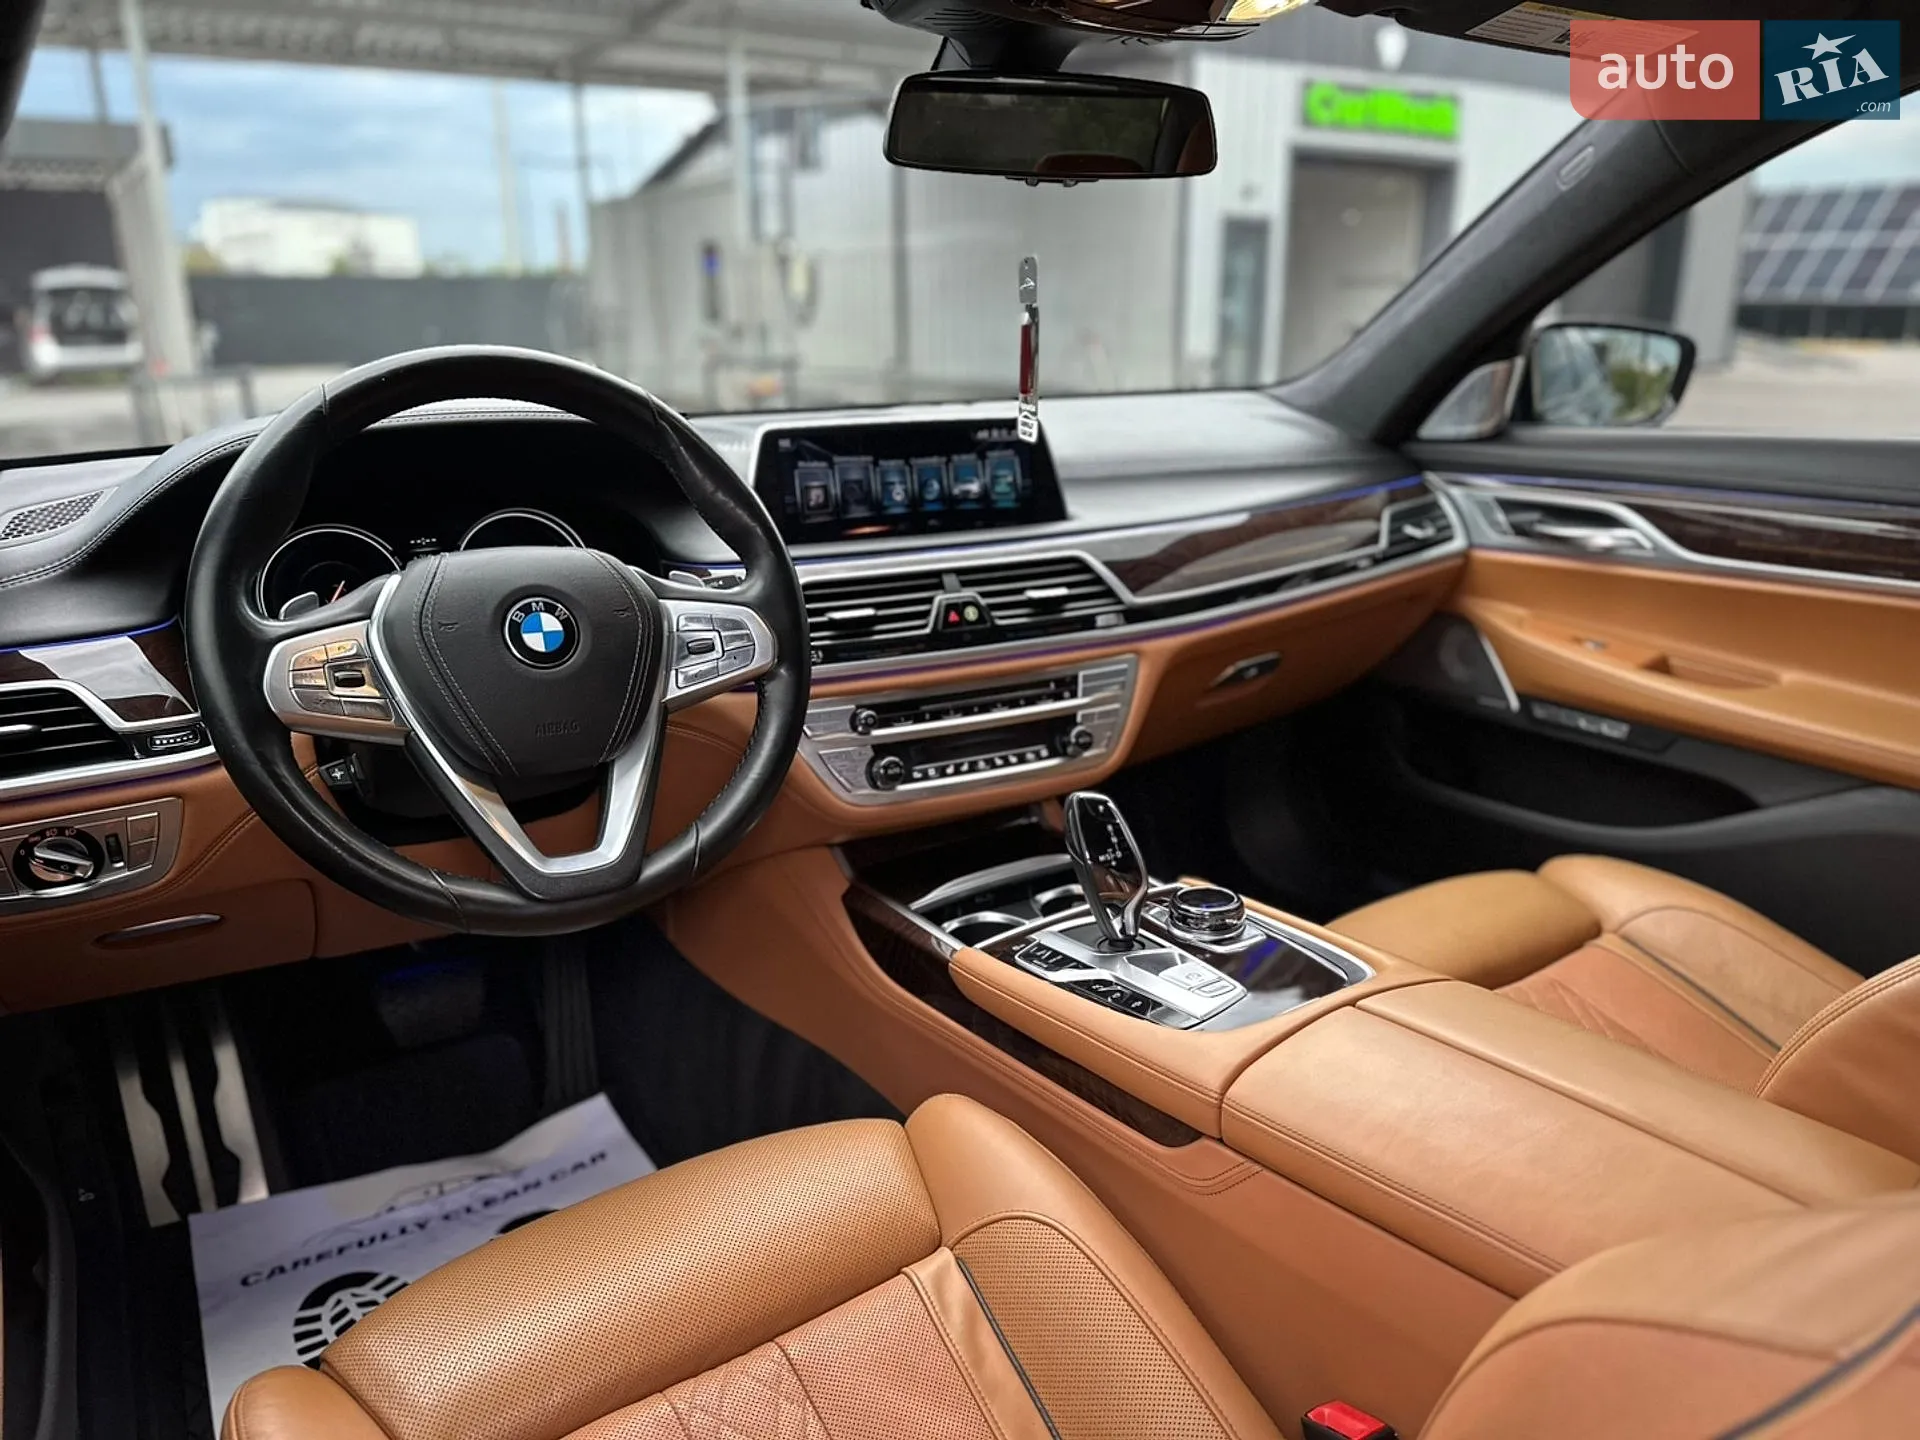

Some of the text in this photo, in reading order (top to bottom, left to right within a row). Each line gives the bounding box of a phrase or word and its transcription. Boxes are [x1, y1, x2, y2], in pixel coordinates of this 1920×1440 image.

[512, 602, 567, 623] BMW
[240, 1151, 608, 1287] CAREFULLY CLEAN CAR
